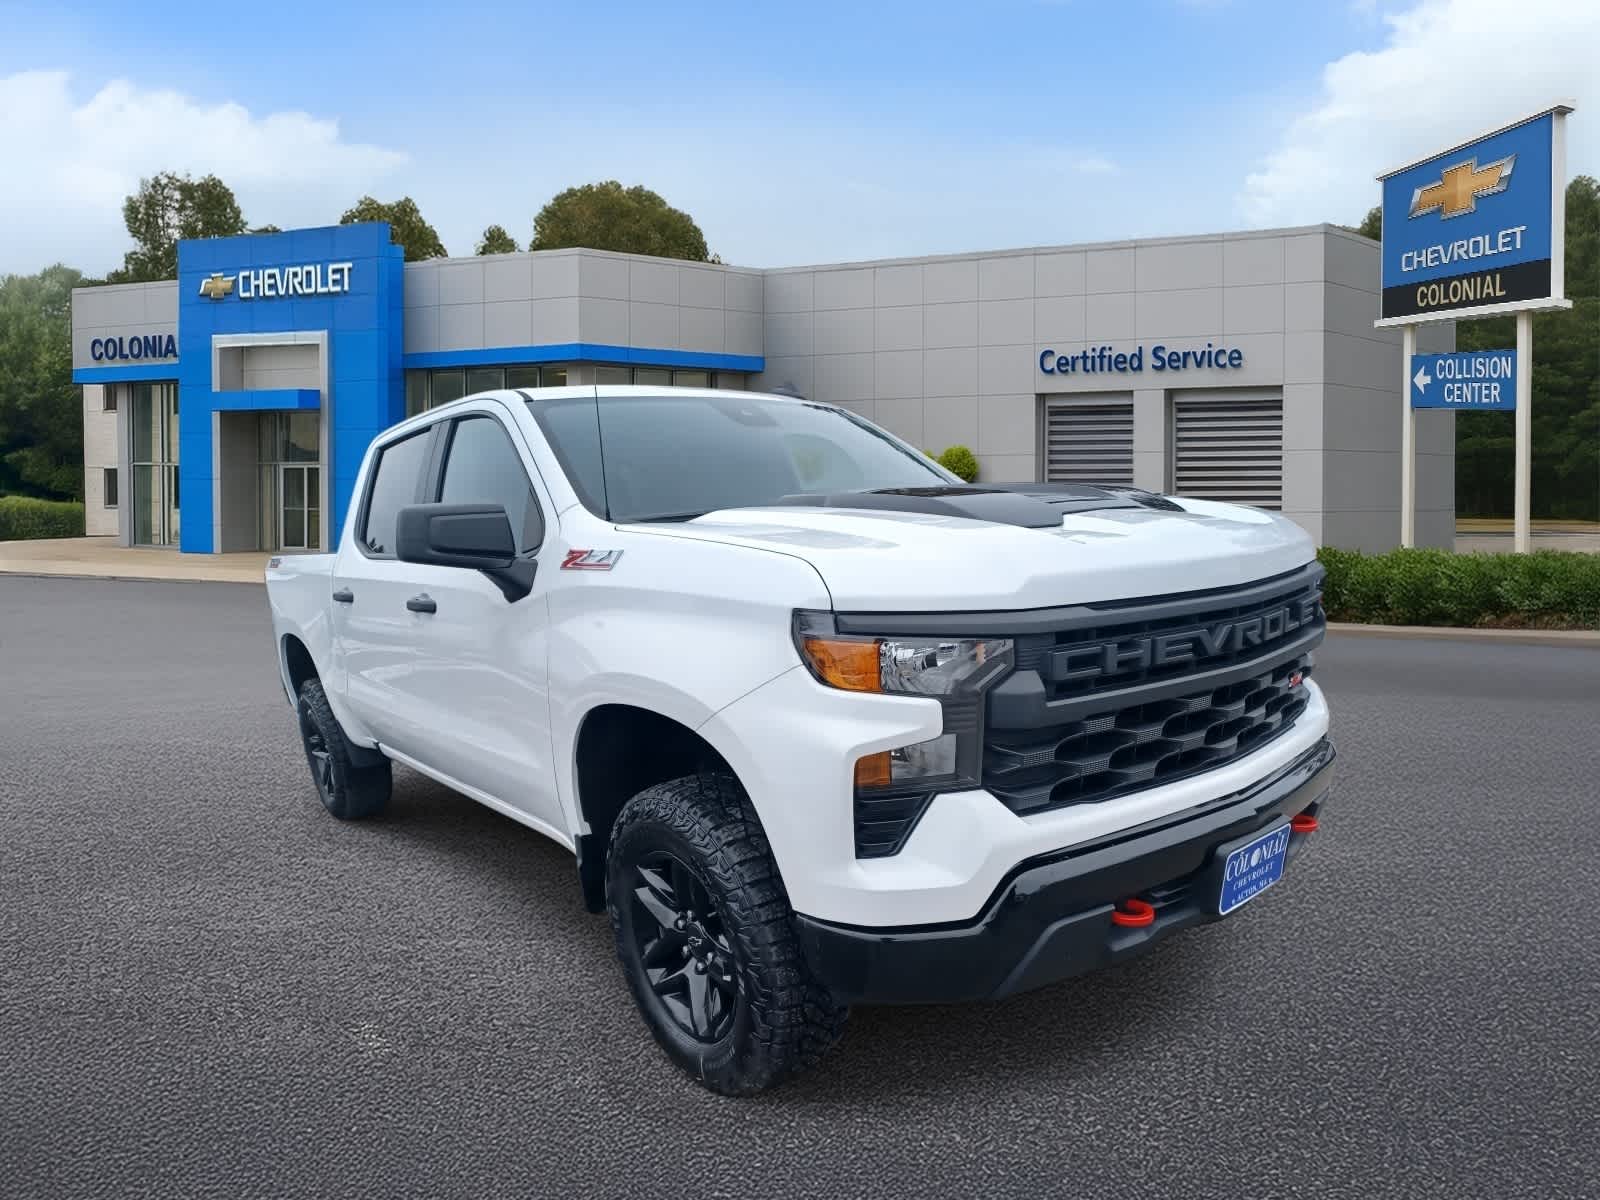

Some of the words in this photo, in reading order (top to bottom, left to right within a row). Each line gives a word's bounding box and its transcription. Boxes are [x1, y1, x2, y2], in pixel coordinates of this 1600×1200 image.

[1401, 225, 1528, 272] CHEVROLET
[238, 262, 352, 299] CHEVROLET
[1416, 273, 1506, 308] COLONIAL
[90, 334, 178, 361] COLONIA
[1039, 345, 1144, 375] Certified
[1151, 343, 1243, 371] Service
[1435, 356, 1512, 380] COLLISION
[1444, 382, 1501, 403] CENTER
[1226, 833, 1286, 882] COLONIAL
[1233, 861, 1274, 891] CHEVROLET
